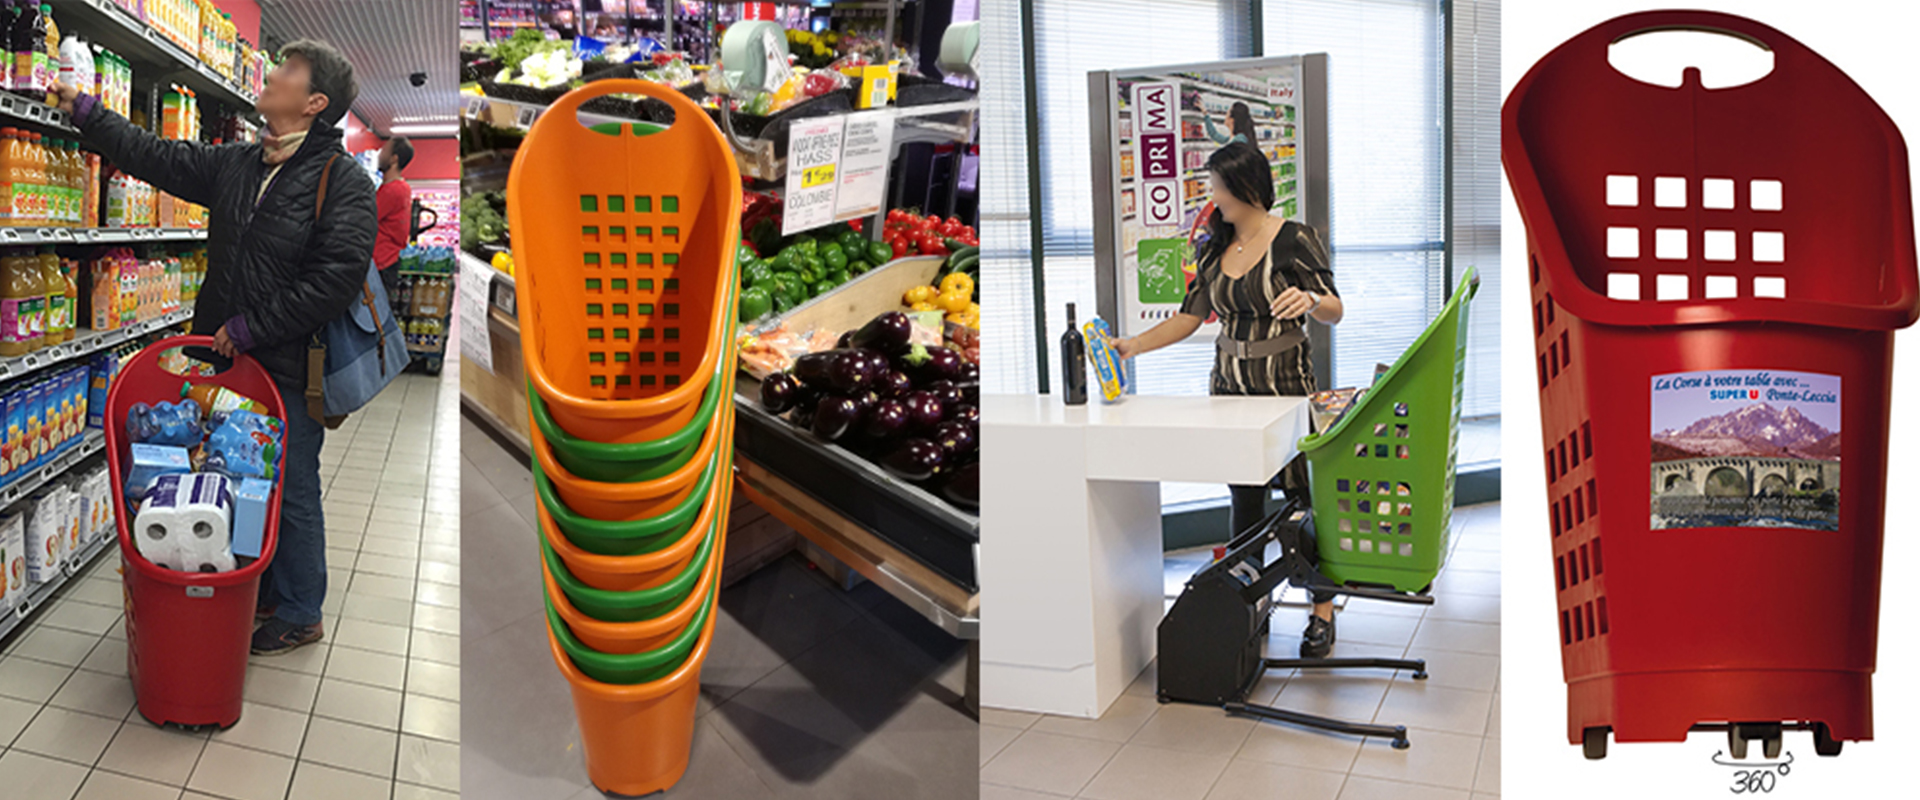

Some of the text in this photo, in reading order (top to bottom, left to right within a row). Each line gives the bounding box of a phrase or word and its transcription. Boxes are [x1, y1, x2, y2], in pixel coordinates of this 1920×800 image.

[796, 148, 833, 167] HASS
[1654, 378, 1670, 391] La
[1673, 376, 1701, 390] Corse
[1704, 374, 1712, 388] à
[1713, 375, 1742, 387] votre
[1744, 372, 1772, 387] table
[1709, 387, 1837, 404] SUPER U Ponte-Leccia
